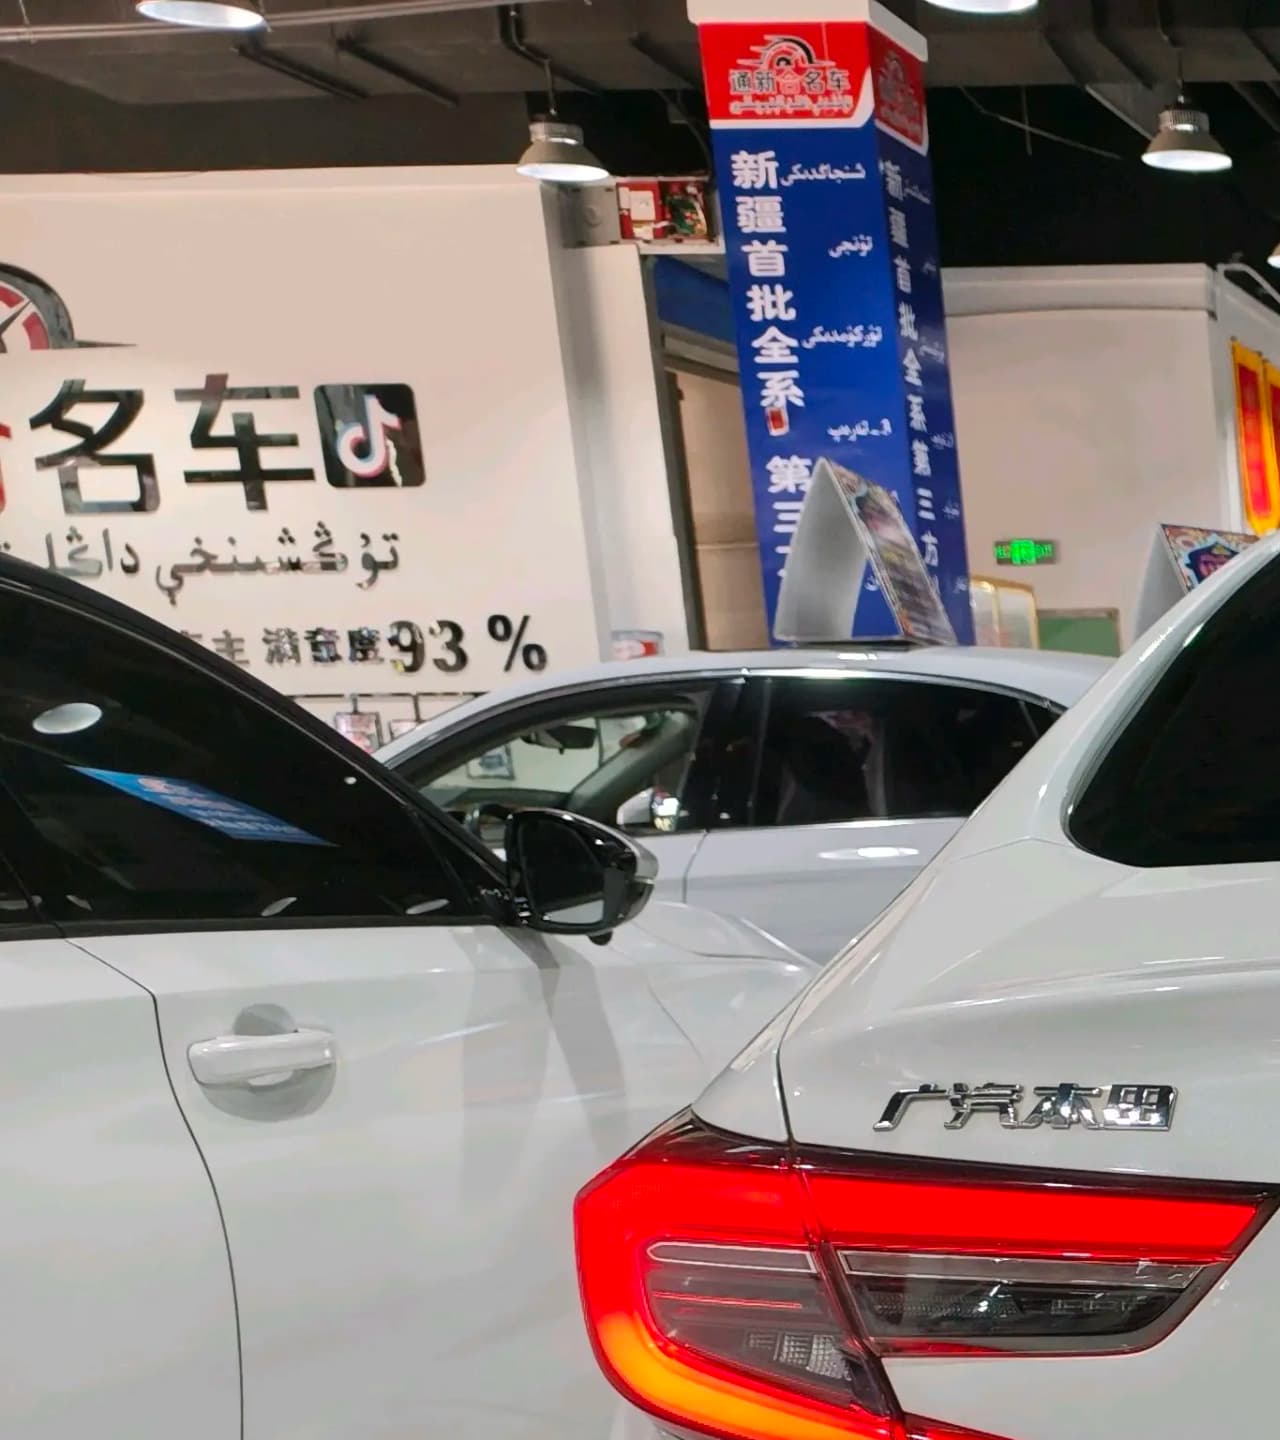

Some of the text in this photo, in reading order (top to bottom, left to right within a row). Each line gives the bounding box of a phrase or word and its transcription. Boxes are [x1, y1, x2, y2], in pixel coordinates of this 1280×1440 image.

[728, 68, 852, 96] 通新合名车
[731, 150, 805, 408] 新疆首批全系
[0, 372, 315, 514] 名车
[872, 1082, 1178, 1132] 广汽本田
